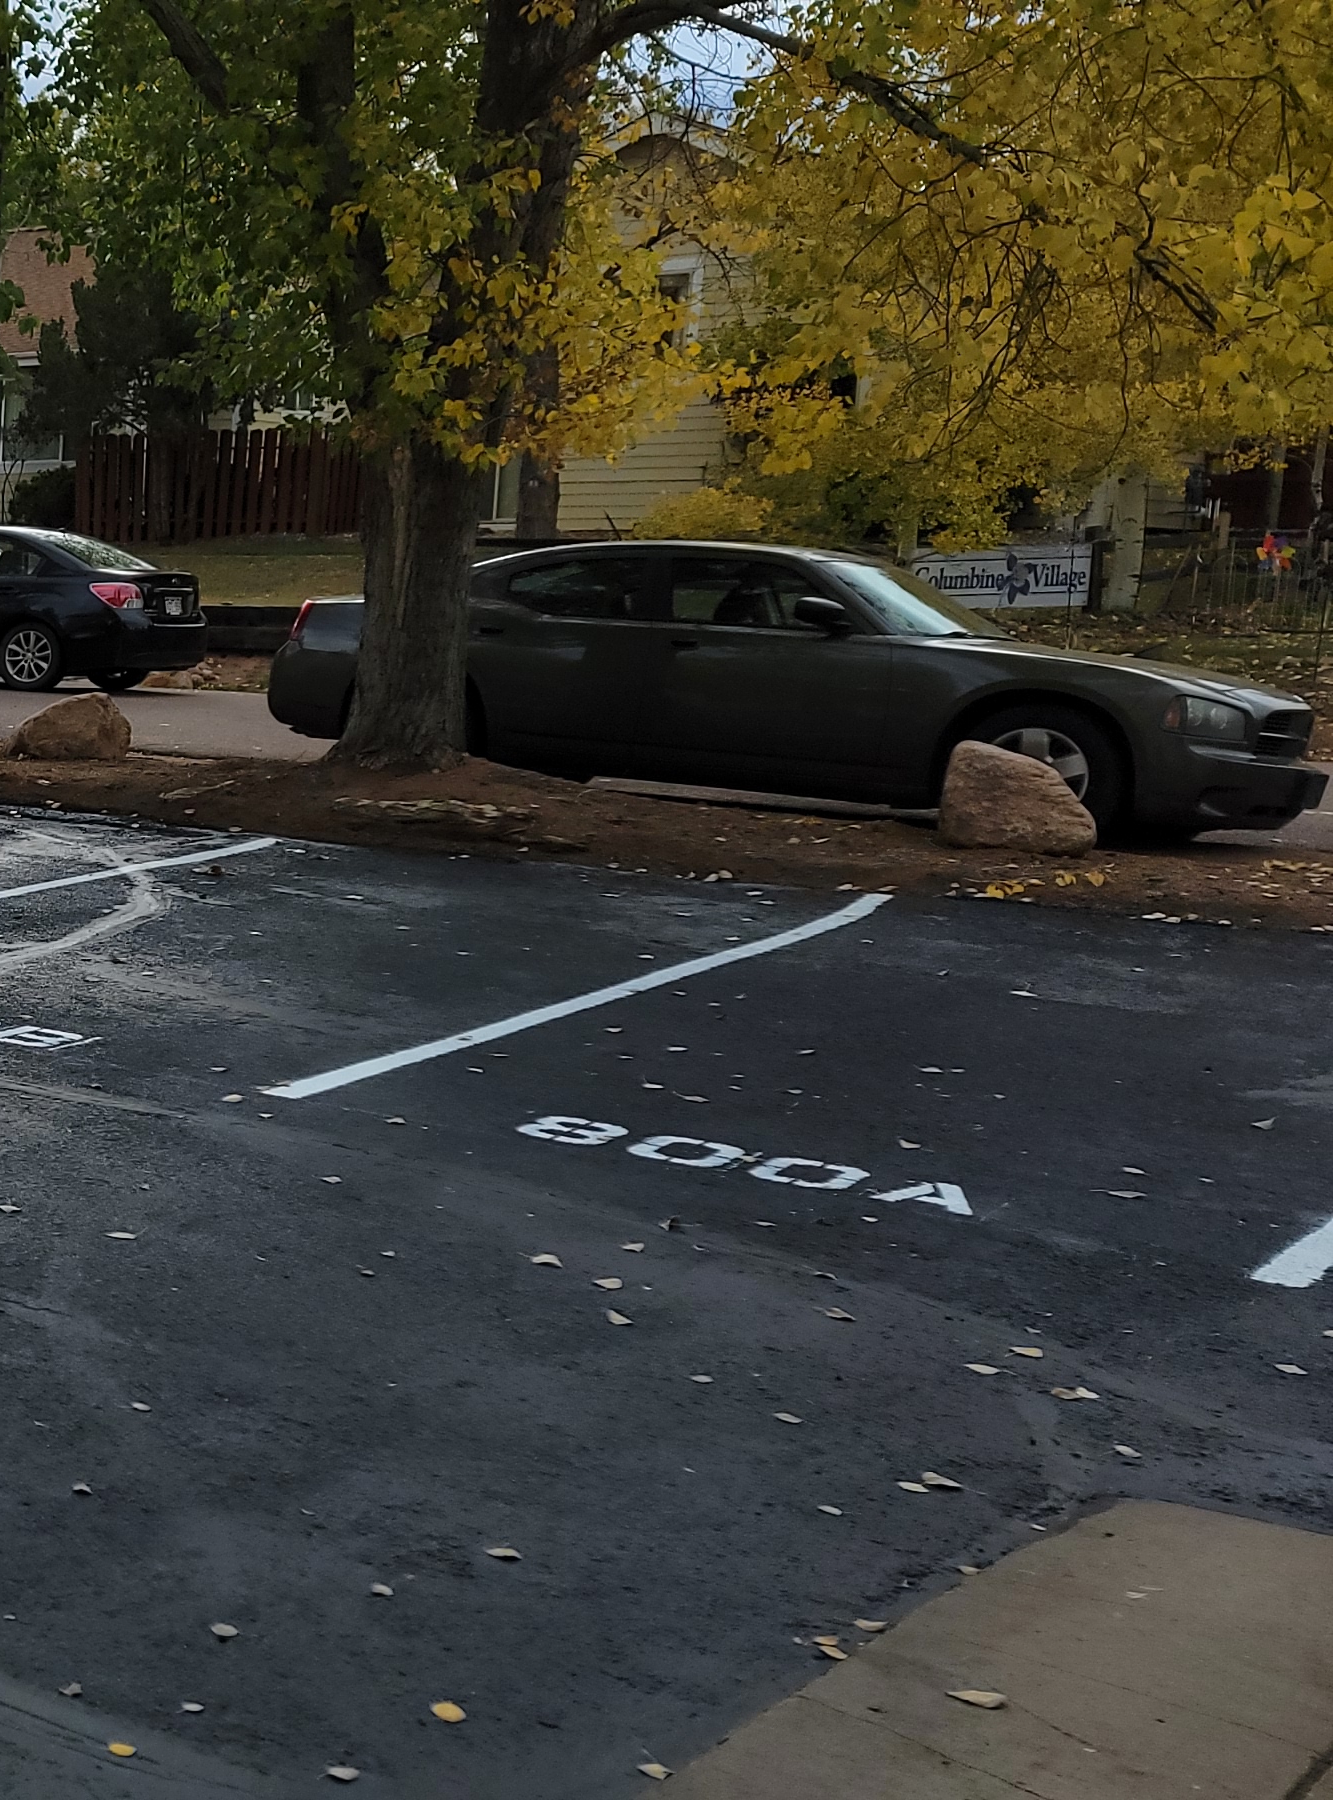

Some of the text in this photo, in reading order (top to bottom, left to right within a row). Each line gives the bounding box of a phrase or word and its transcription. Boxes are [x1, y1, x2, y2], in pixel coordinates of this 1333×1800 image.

[916, 564, 1087, 592] Columbine Village
[515, 1115, 974, 1215] 800A
